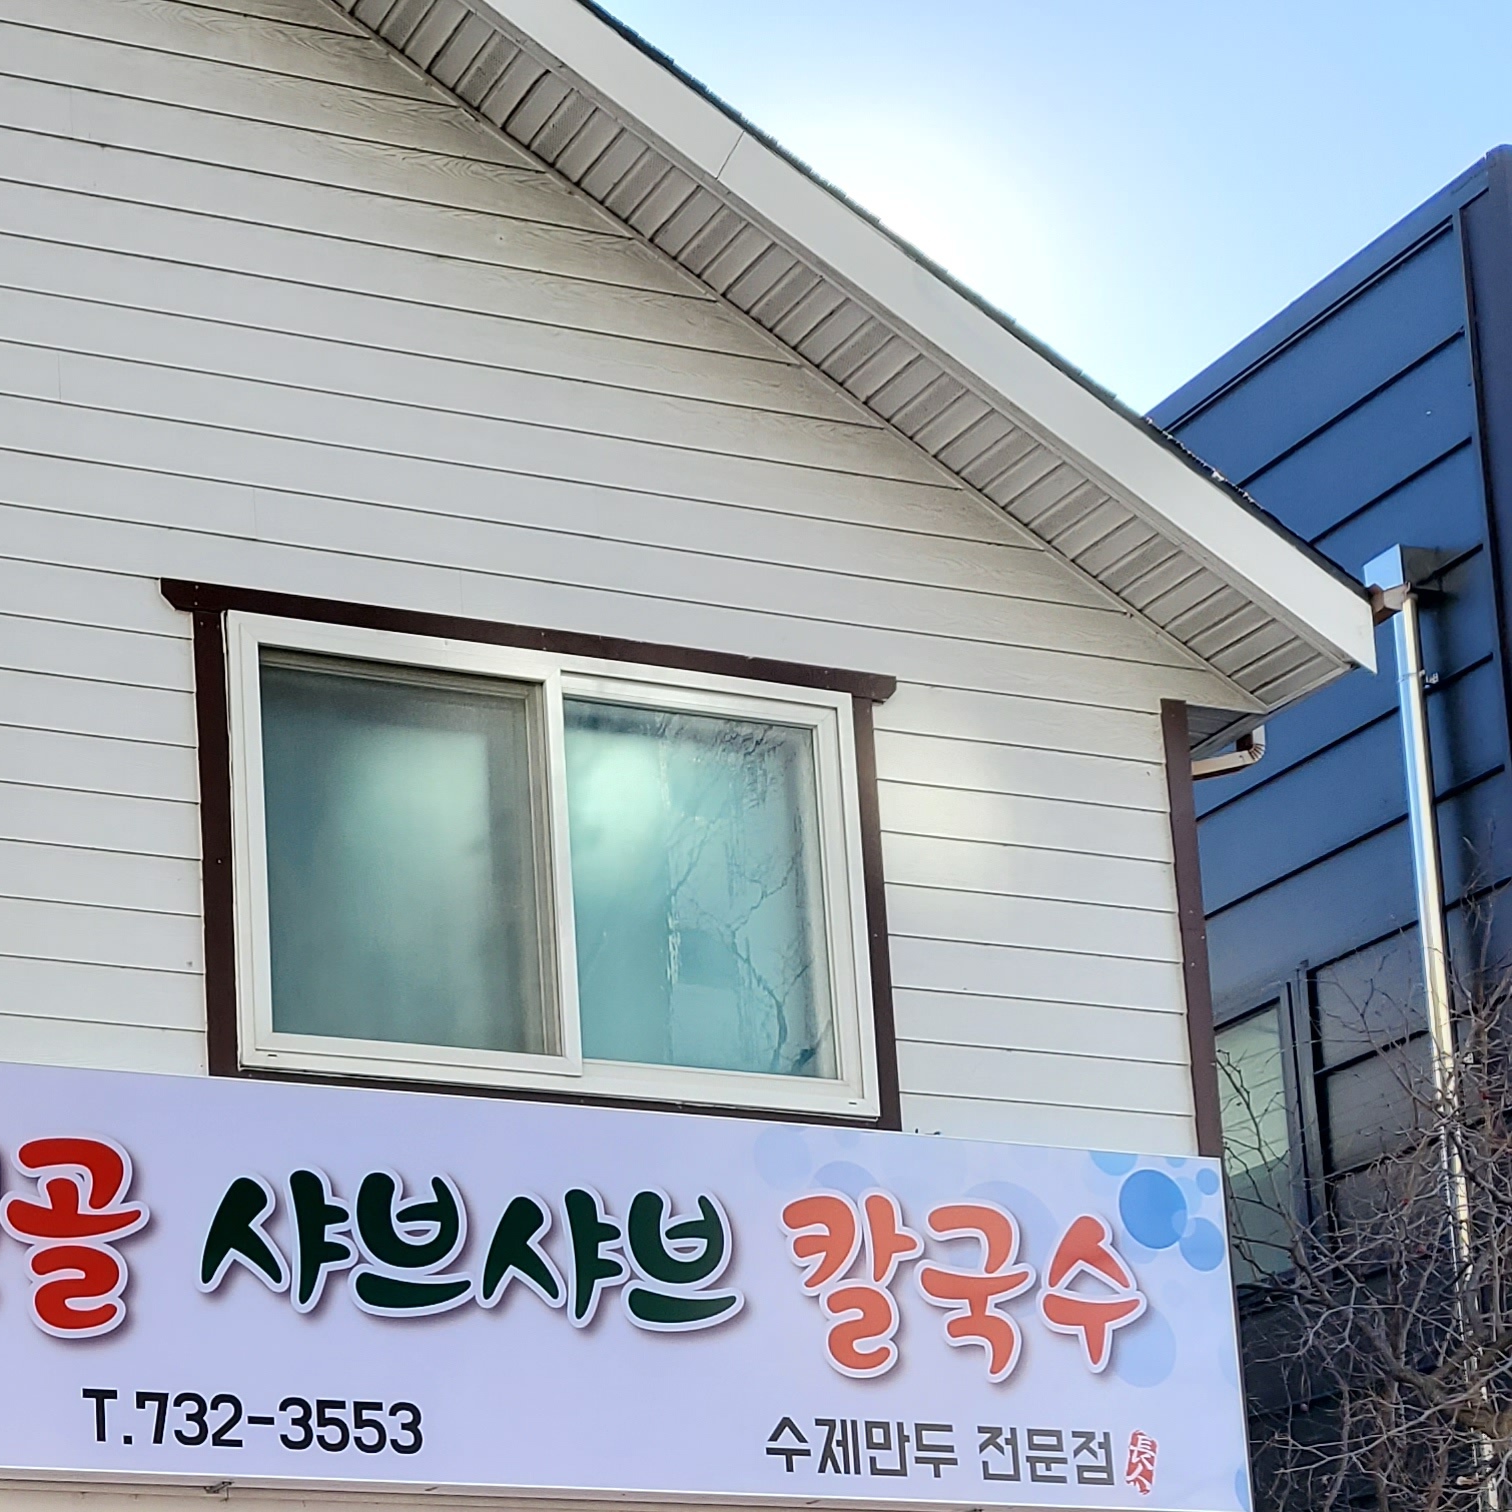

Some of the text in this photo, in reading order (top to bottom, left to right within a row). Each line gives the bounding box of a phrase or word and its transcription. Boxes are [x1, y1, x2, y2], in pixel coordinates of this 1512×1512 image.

[200, 1168, 739, 1325] 샤브샤브
[781, 1193, 1143, 1377] 칼국수
[82, 1387, 424, 1456] T.732-3553
[764, 1416, 1116, 1486] 수제만두 전문점
